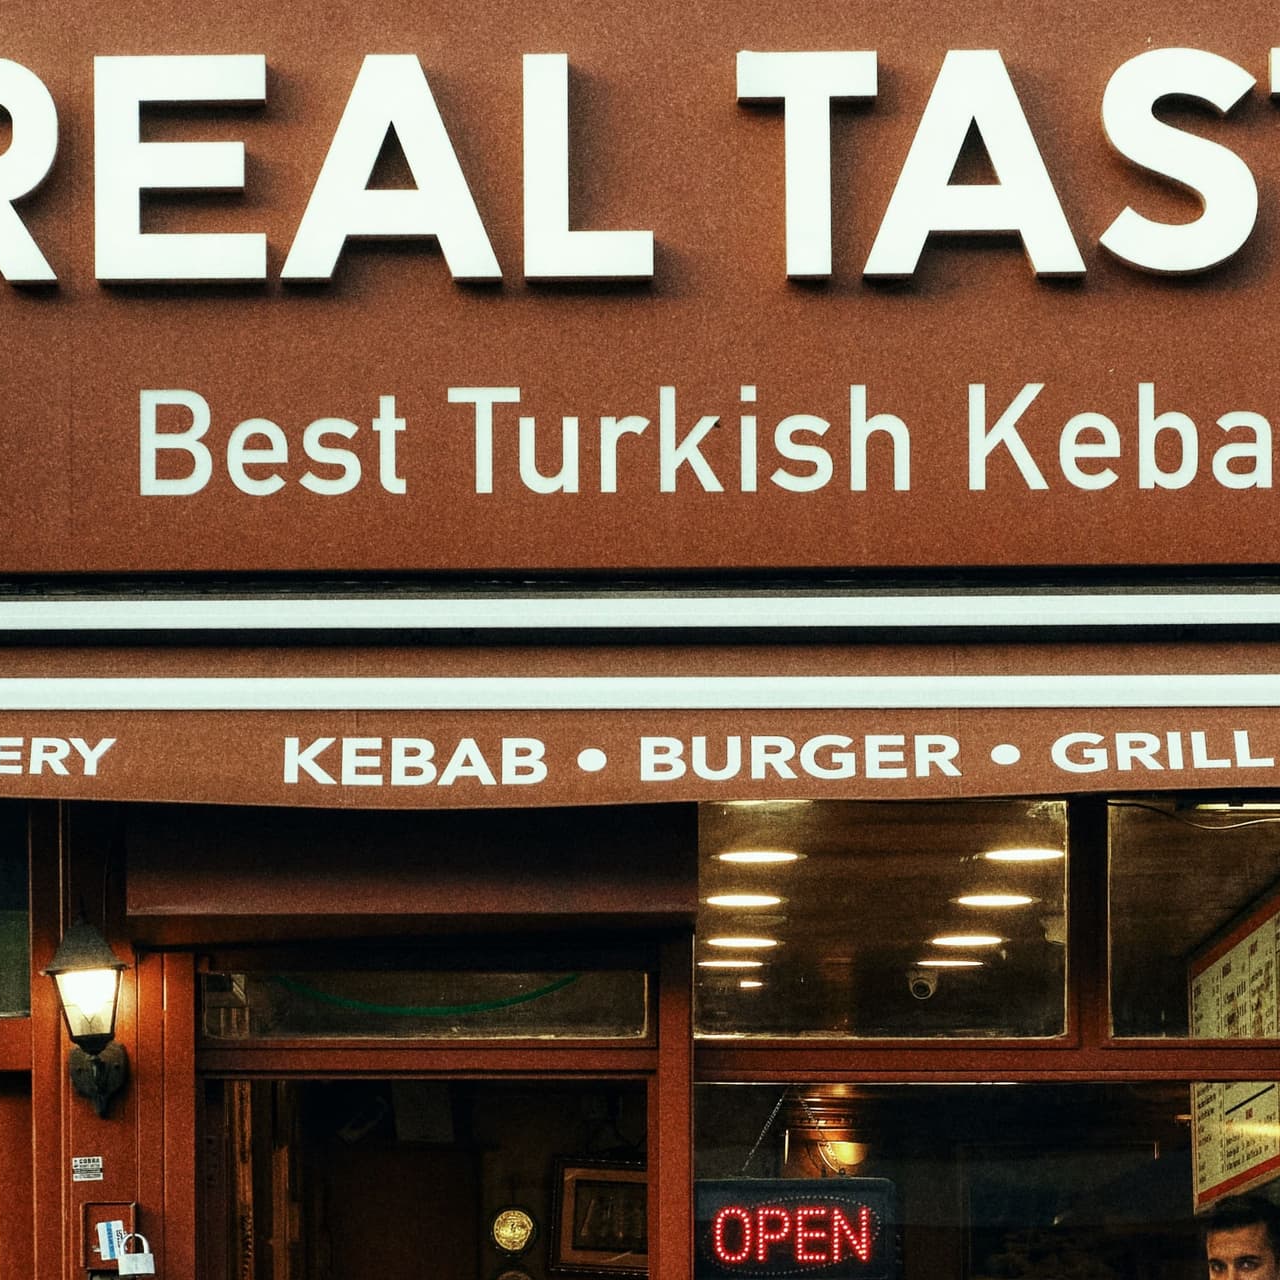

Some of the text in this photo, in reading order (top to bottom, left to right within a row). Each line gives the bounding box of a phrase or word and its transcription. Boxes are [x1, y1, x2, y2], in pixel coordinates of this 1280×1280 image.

[138, 388, 406, 495] Best
[447, 385, 911, 494] Turkish
[283, 730, 1275, 787] KEBAB BURGER GRILL
[714, 1206, 874, 1264] OPEN
